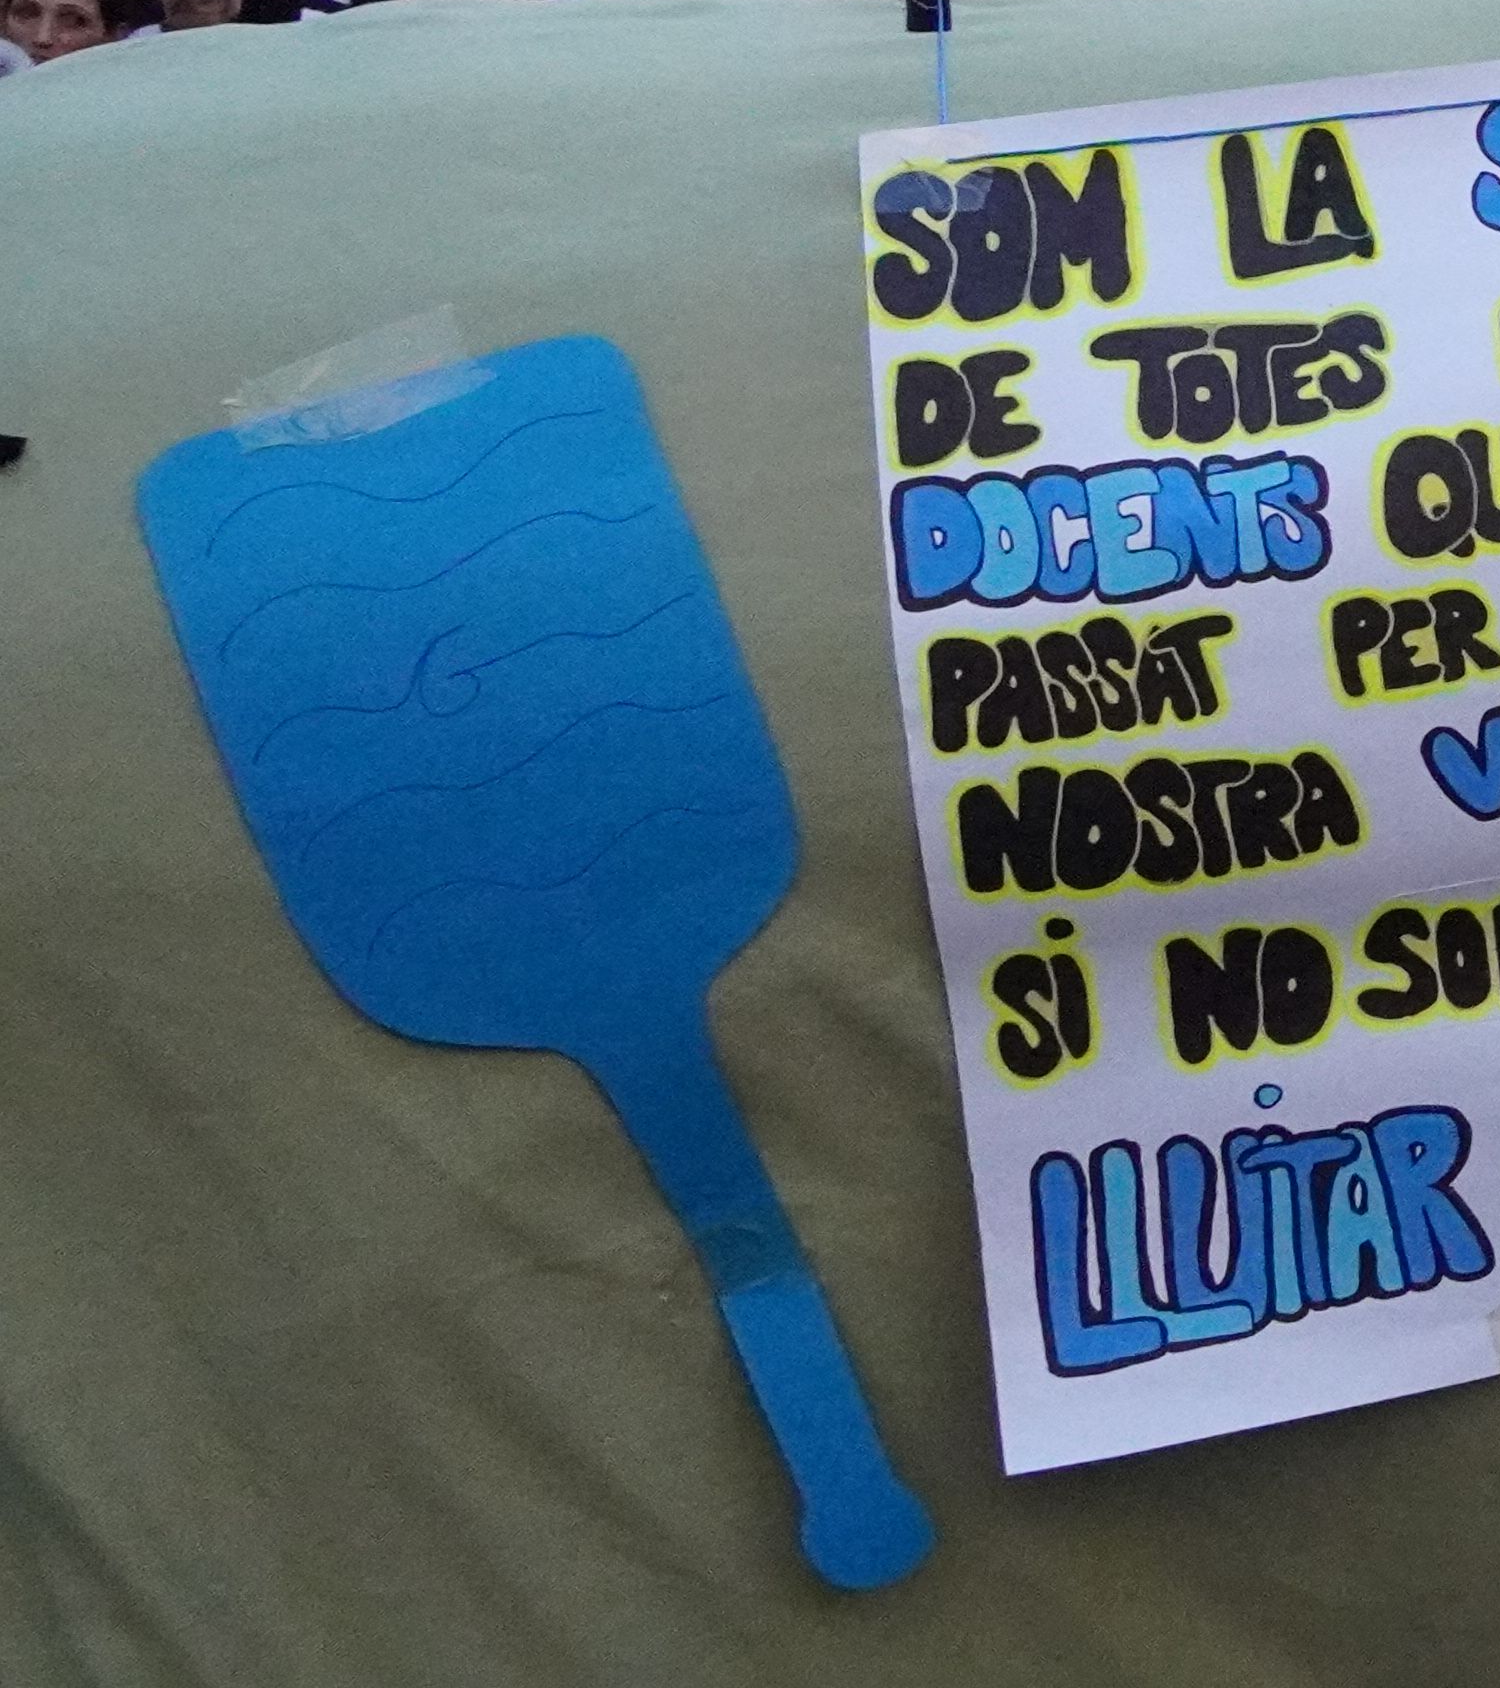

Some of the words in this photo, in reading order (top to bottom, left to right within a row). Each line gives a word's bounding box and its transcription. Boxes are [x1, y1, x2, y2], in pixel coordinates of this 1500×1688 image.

[871, 148, 1133, 320] SOM
[1220, 128, 1375, 279] LA
[895, 351, 1041, 467] DE
[1091, 312, 1388, 444] TOTES
[891, 451, 1330, 611] DOCENTS
[929, 613, 1232, 752] PASSAT
[961, 759, 1362, 893] NOSTRA
[1167, 927, 1333, 1066] NO
